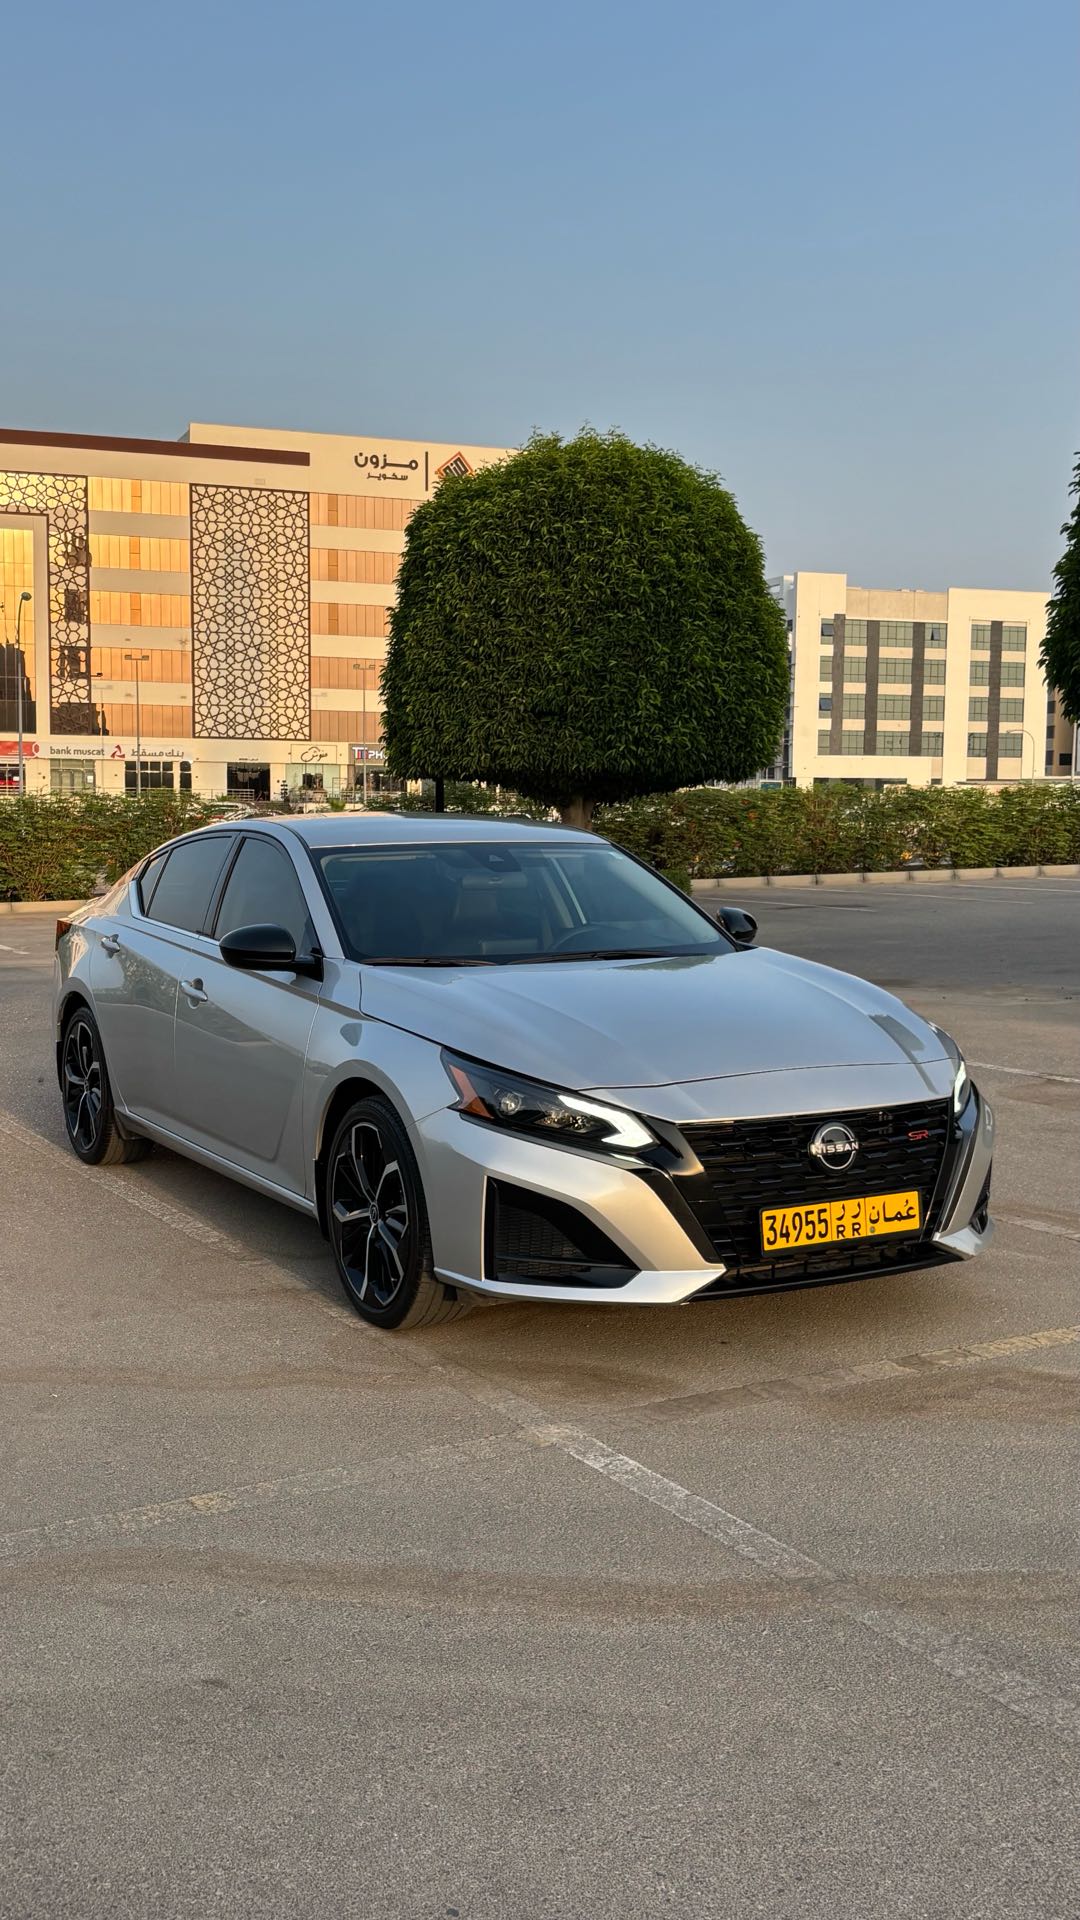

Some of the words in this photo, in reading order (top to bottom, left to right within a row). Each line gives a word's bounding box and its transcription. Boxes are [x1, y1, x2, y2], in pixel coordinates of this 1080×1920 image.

[354, 452, 418, 470] مزون
[366, 472, 408, 481] سكوير
[50, 746, 72, 755] bank
[73, 747, 105, 756] muscat
[131, 748, 164, 757] مسقط
[165, 749, 184, 759] بنك
[908, 1129, 929, 1140] SR
[811, 1141, 859, 1155] NISSAN
[765, 1208, 829, 1246] 34955
